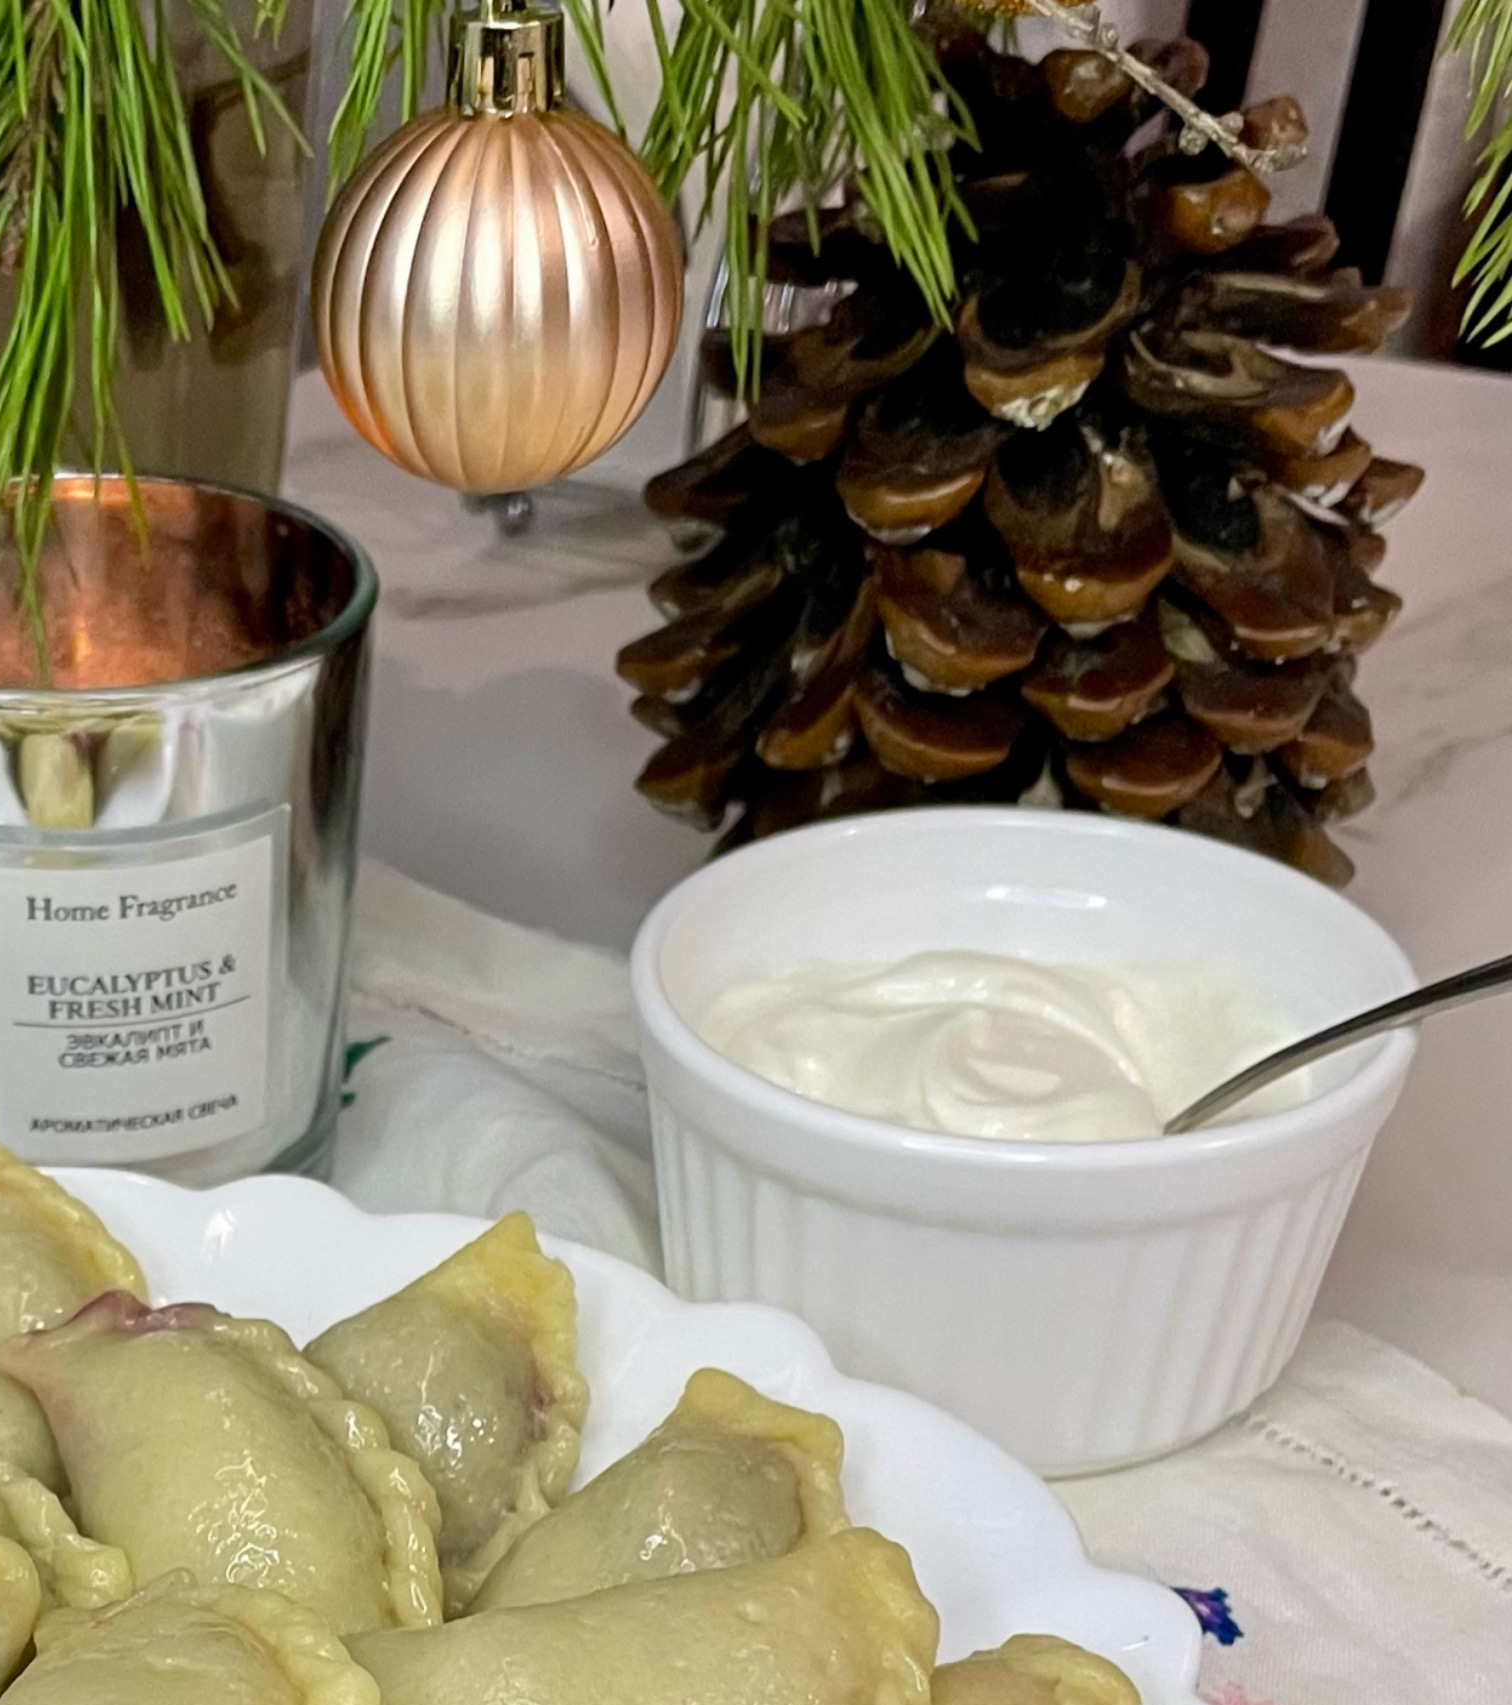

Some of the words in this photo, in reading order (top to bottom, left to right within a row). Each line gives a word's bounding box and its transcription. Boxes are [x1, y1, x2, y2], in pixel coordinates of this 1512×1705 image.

[26, 896, 110, 922] Home
[119, 883, 238, 922] Fragrance
[27, 960, 212, 996] EUCALYPTUS
[218, 954, 237, 974] &
[48, 998, 142, 1020] FRESH
[150, 982, 222, 1013] MINT
[58, 1047, 150, 1068] СВЕЖАЯ
[156, 1036, 211, 1061] МЯТА
[65, 1023, 182, 1050] ЭВКАЛИПТ
[190, 1019, 205, 1036] И
[30, 1108, 183, 1134] АРОМАТИЧЕСКАЯ
